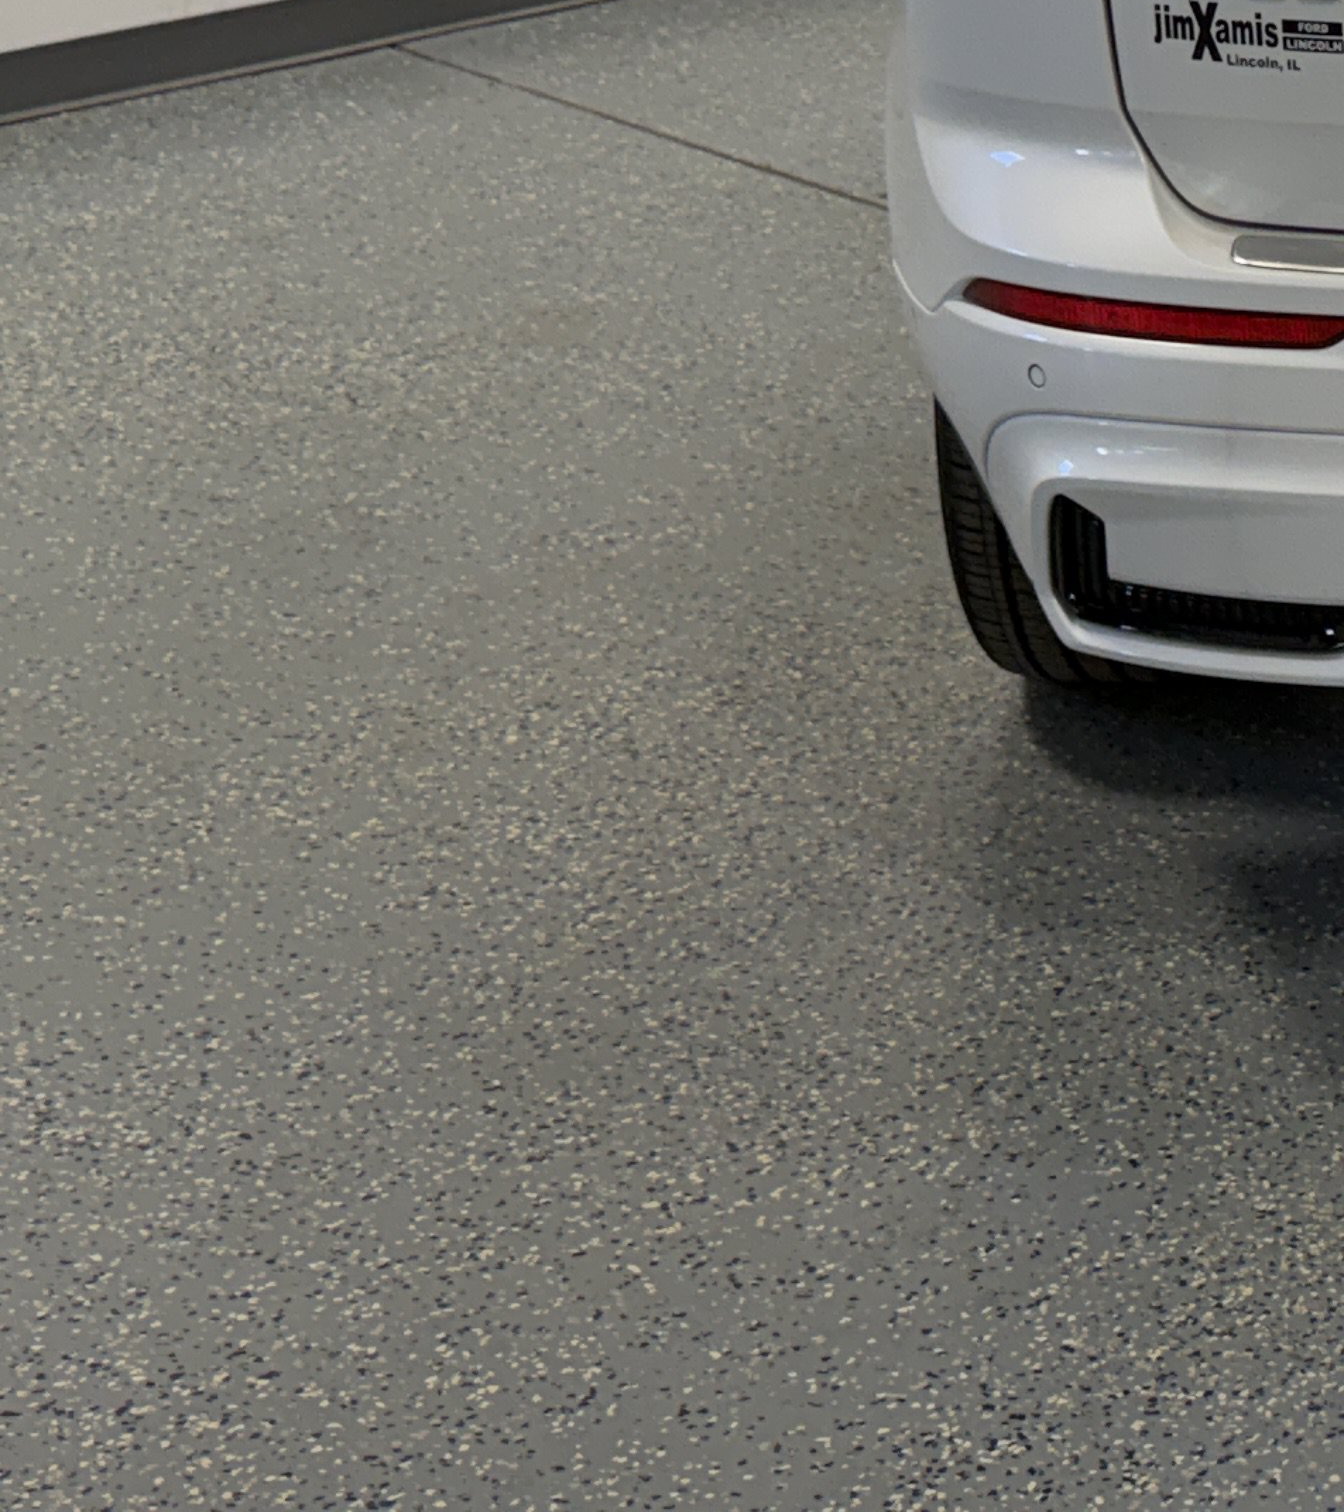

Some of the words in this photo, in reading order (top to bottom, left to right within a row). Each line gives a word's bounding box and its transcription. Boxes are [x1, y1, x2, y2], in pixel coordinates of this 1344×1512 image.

[1154, 0, 1279, 62] jimXamis
[1298, 21, 1329, 34] FORD
[1285, 40, 1343, 52] LINCOLN
[1226, 53, 1284, 72] Lincoln,
[1287, 59, 1301, 71] IL
